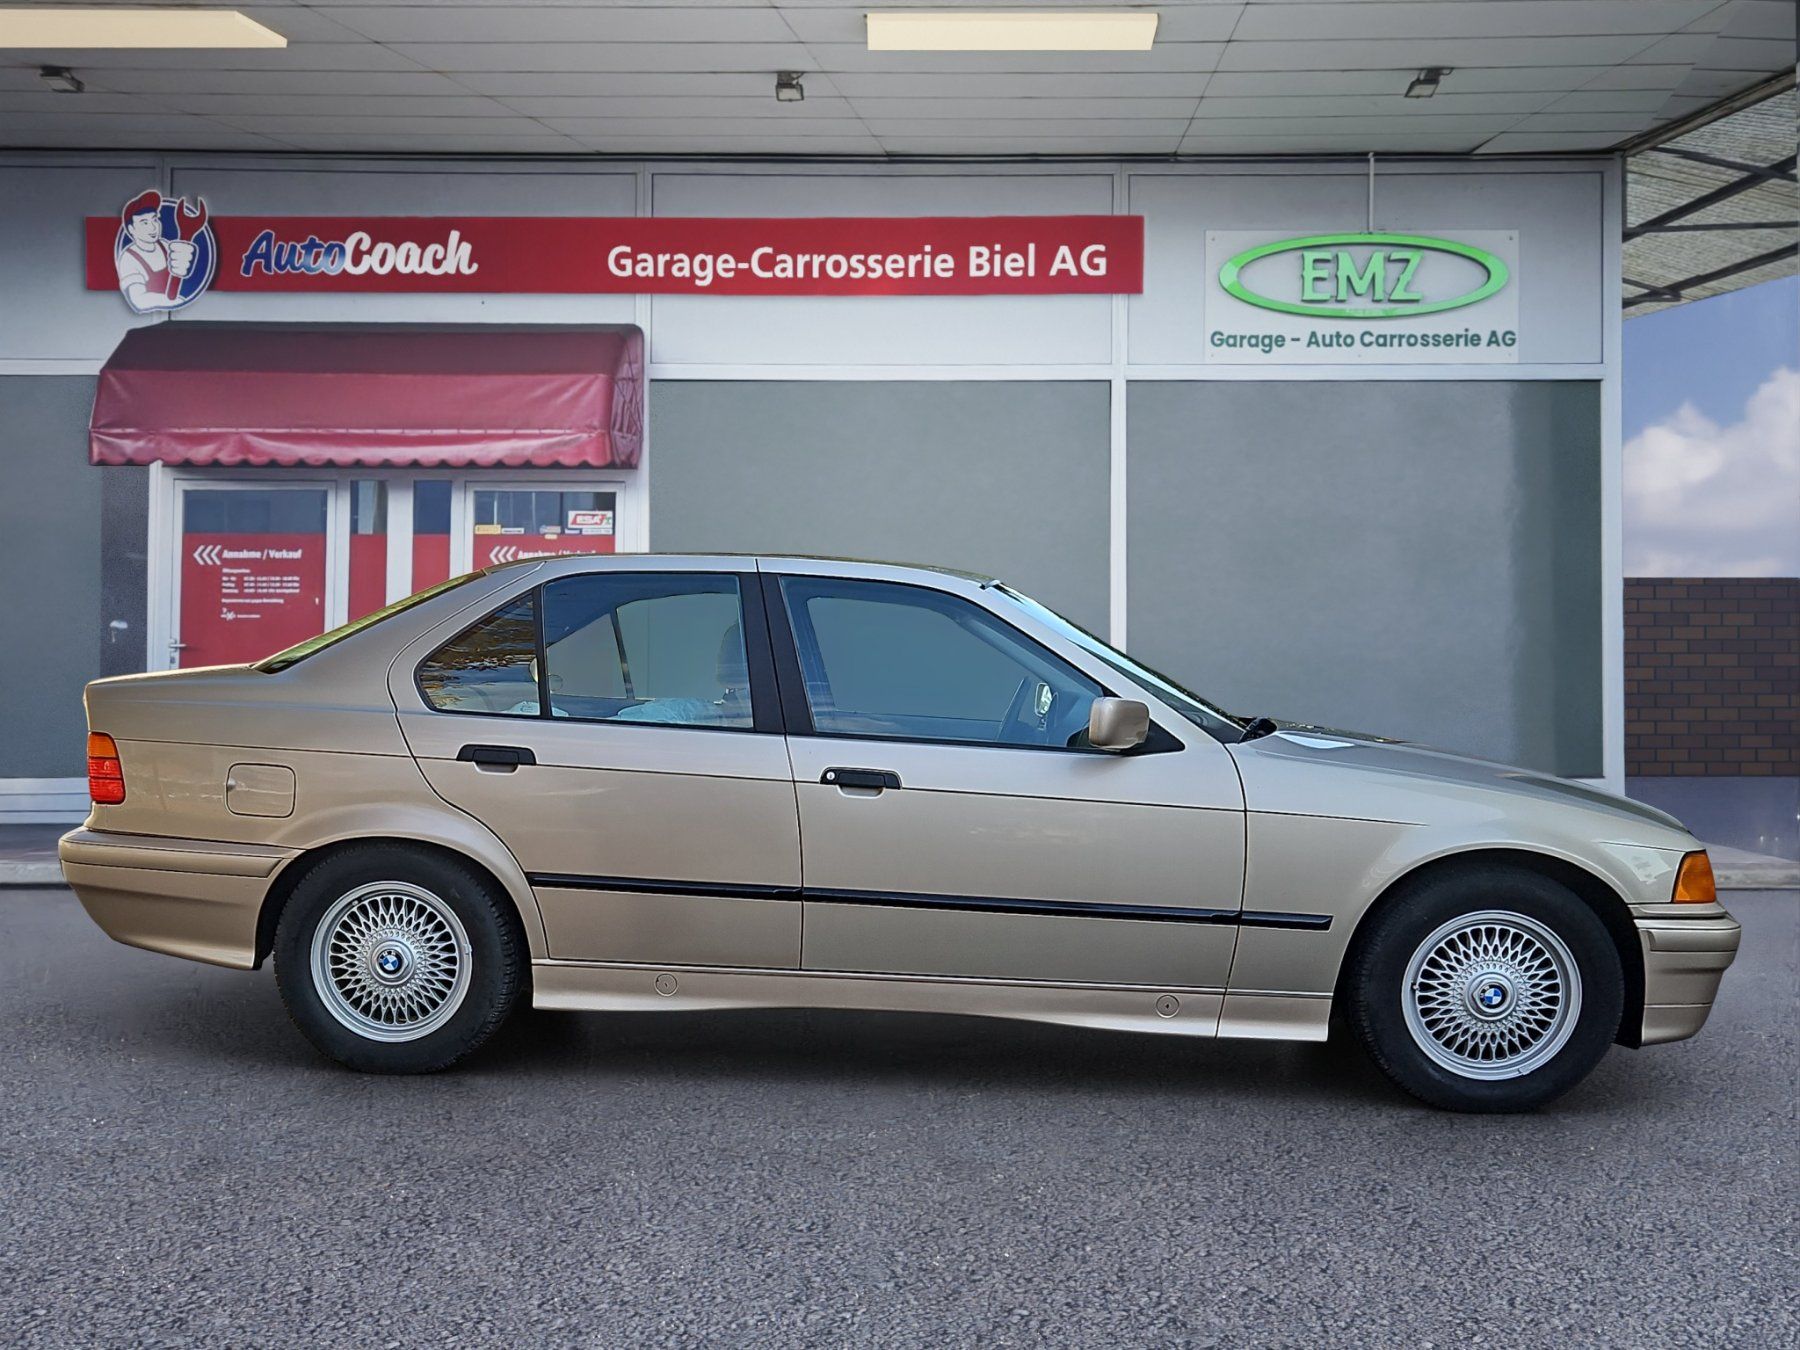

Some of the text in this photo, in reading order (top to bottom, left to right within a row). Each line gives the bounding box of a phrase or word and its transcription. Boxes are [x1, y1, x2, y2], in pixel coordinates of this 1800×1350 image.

[241, 229, 478, 277] AutoCoach
[607, 243, 1107, 286] Garage-Carrosserie Biel AG
[1301, 250, 1425, 303] EMZ
[1210, 331, 1286, 353] Garage
[1306, 331, 1355, 348] Auto
[1360, 328, 1482, 348] Carrosserie
[1486, 331, 1517, 347] AG
